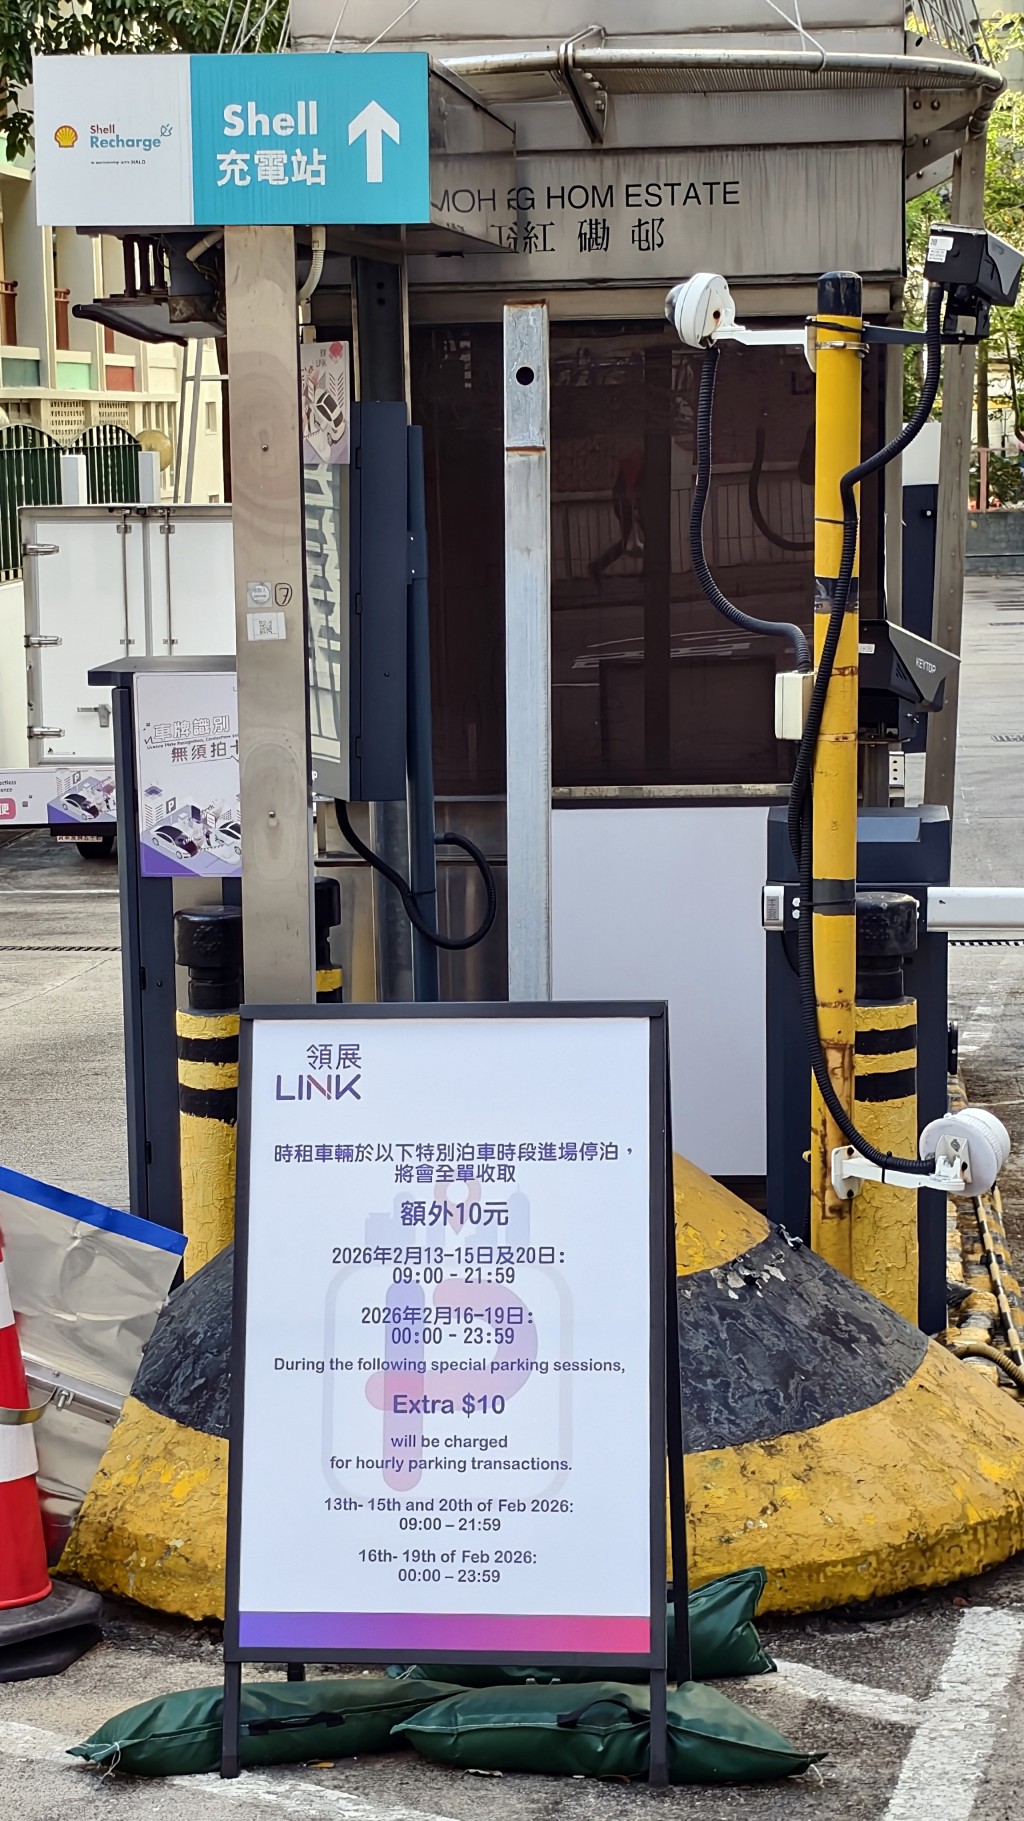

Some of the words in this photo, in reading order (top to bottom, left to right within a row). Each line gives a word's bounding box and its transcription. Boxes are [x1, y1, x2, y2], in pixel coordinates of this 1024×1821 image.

[223, 100, 318, 137] Shell
[90, 124, 115, 134] Shell
[90, 135, 161, 151] Recharge
[216, 148, 327, 187] 充電站
[546, 184, 614, 210] HOM
[625, 181, 740, 208] ESTATE
[915, 657, 937, 674] KEYTOP
[153, 715, 230, 741] 車牌識別
[306, 1043, 362, 1071] 領展
[275, 1074, 362, 1101] LINK
[394, 1163, 516, 1184] 將會全單收取
[400, 1200, 509, 1227] 額外10元
[392, 1266, 444, 1284] 09:00
[464, 1266, 516, 1284] 21:59
[391, 1327, 443, 1345] 00:00
[463, 1327, 516, 1345] 23:59
[274, 1357, 325, 1375] During
[329, 1357, 353, 1371] the
[357, 1357, 427, 1375] following
[431, 1357, 486, 1375] special
[490, 1357, 549, 1375] parking
[553, 1358, 625, 1374] sessions,
[393, 1394, 454, 1415] Extra
[461, 1393, 506, 1419] $10
[390, 1435, 416, 1449] will
[421, 1435, 440, 1449] be
[444, 1435, 508, 1452] charged
[329, 1456, 352, 1470] for
[356, 1456, 405, 1472] hourly
[408, 1456, 467, 1473] parking
[471, 1457, 572, 1471] transactions.
[324, 1497, 364, 1511] 13th-
[367, 1498, 401, 1512] 15th
[405, 1498, 434, 1512] and
[438, 1498, 473, 1512] 20th
[477, 1498, 493, 1512] of
[498, 1498, 527, 1512] Feb
[531, 1499, 573, 1513] 2026:
[399, 1517, 442, 1532] 09:00
[458, 1517, 501, 1532] 21:59
[358, 1549, 398, 1563] 16th-
[402, 1549, 436, 1563] 19th
[440, 1549, 457, 1563] of
[462, 1550, 490, 1564] Feb
[494, 1550, 537, 1564] 2026:
[398, 1568, 441, 1583] 00:00
[457, 1568, 501, 1583] 23:59
